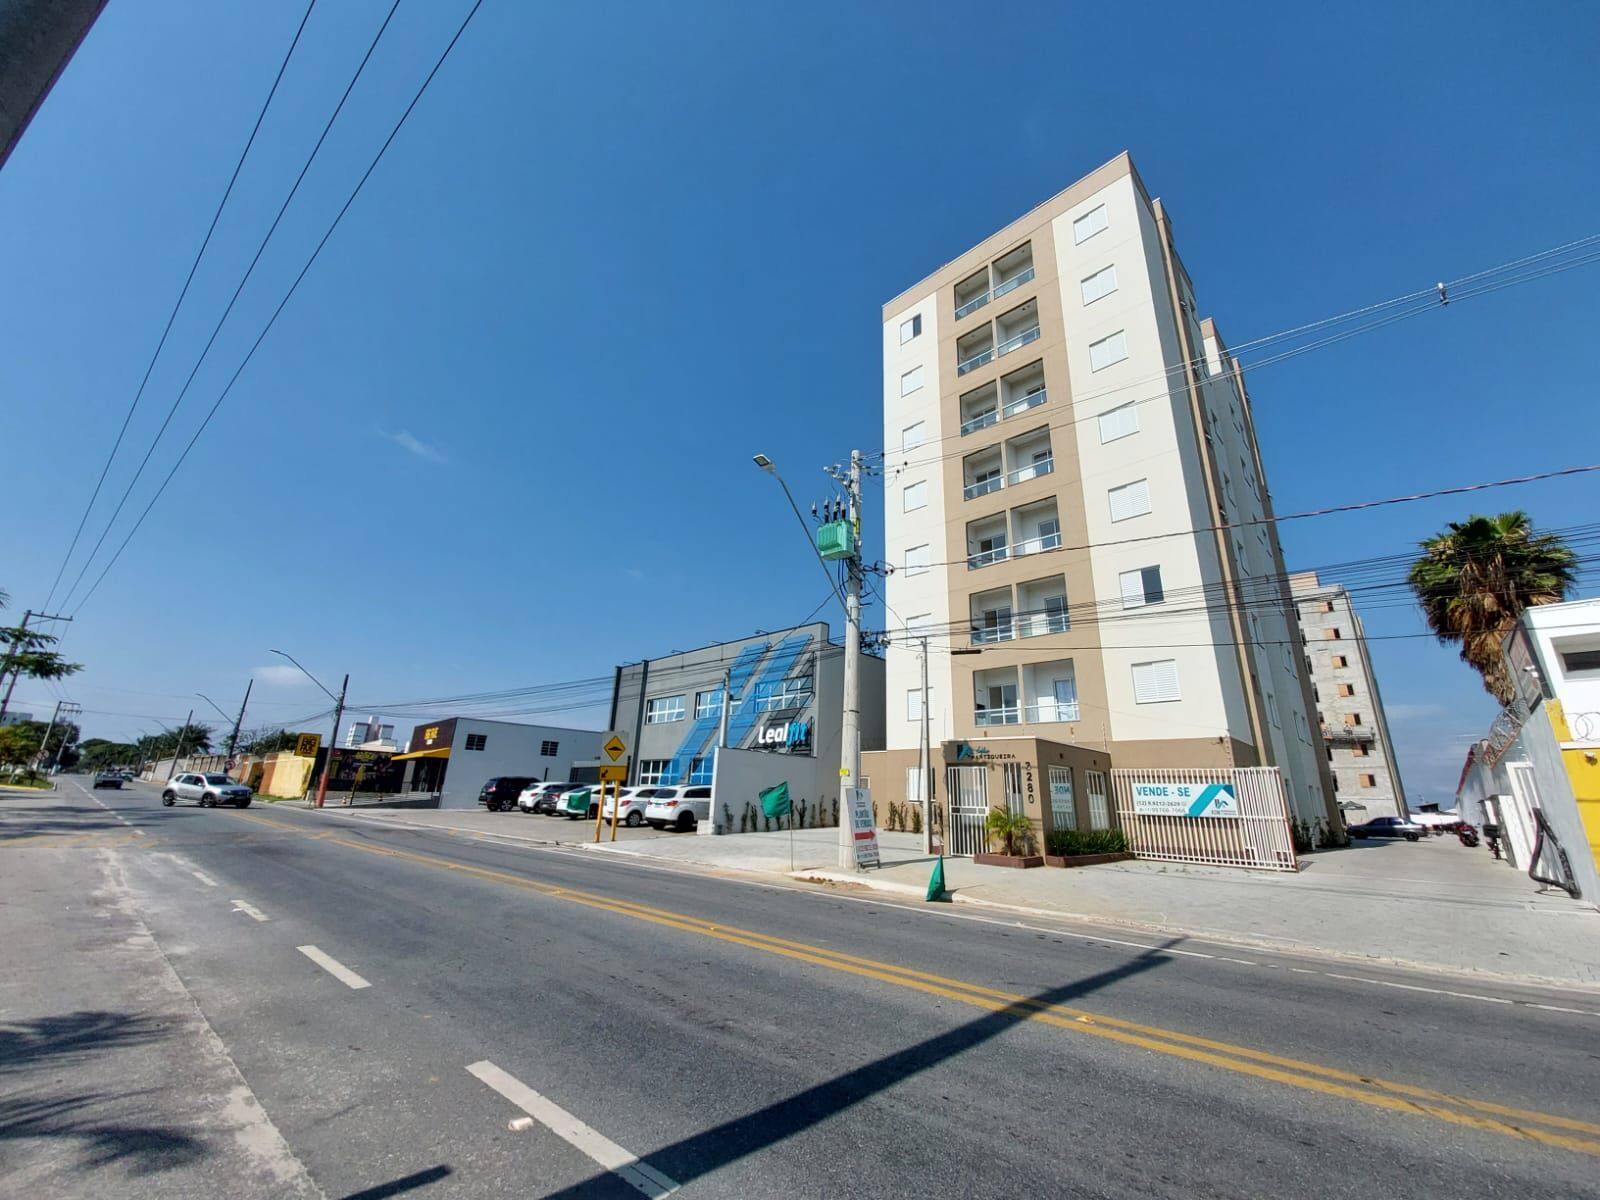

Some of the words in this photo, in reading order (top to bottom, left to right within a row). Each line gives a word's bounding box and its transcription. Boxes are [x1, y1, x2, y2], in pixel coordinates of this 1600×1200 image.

[758, 719, 807, 747] Lealfit
[1025, 761, 1034, 804] 2280
[1136, 786, 1169, 797] VENDE
[1177, 787, 1191, 797] SE
